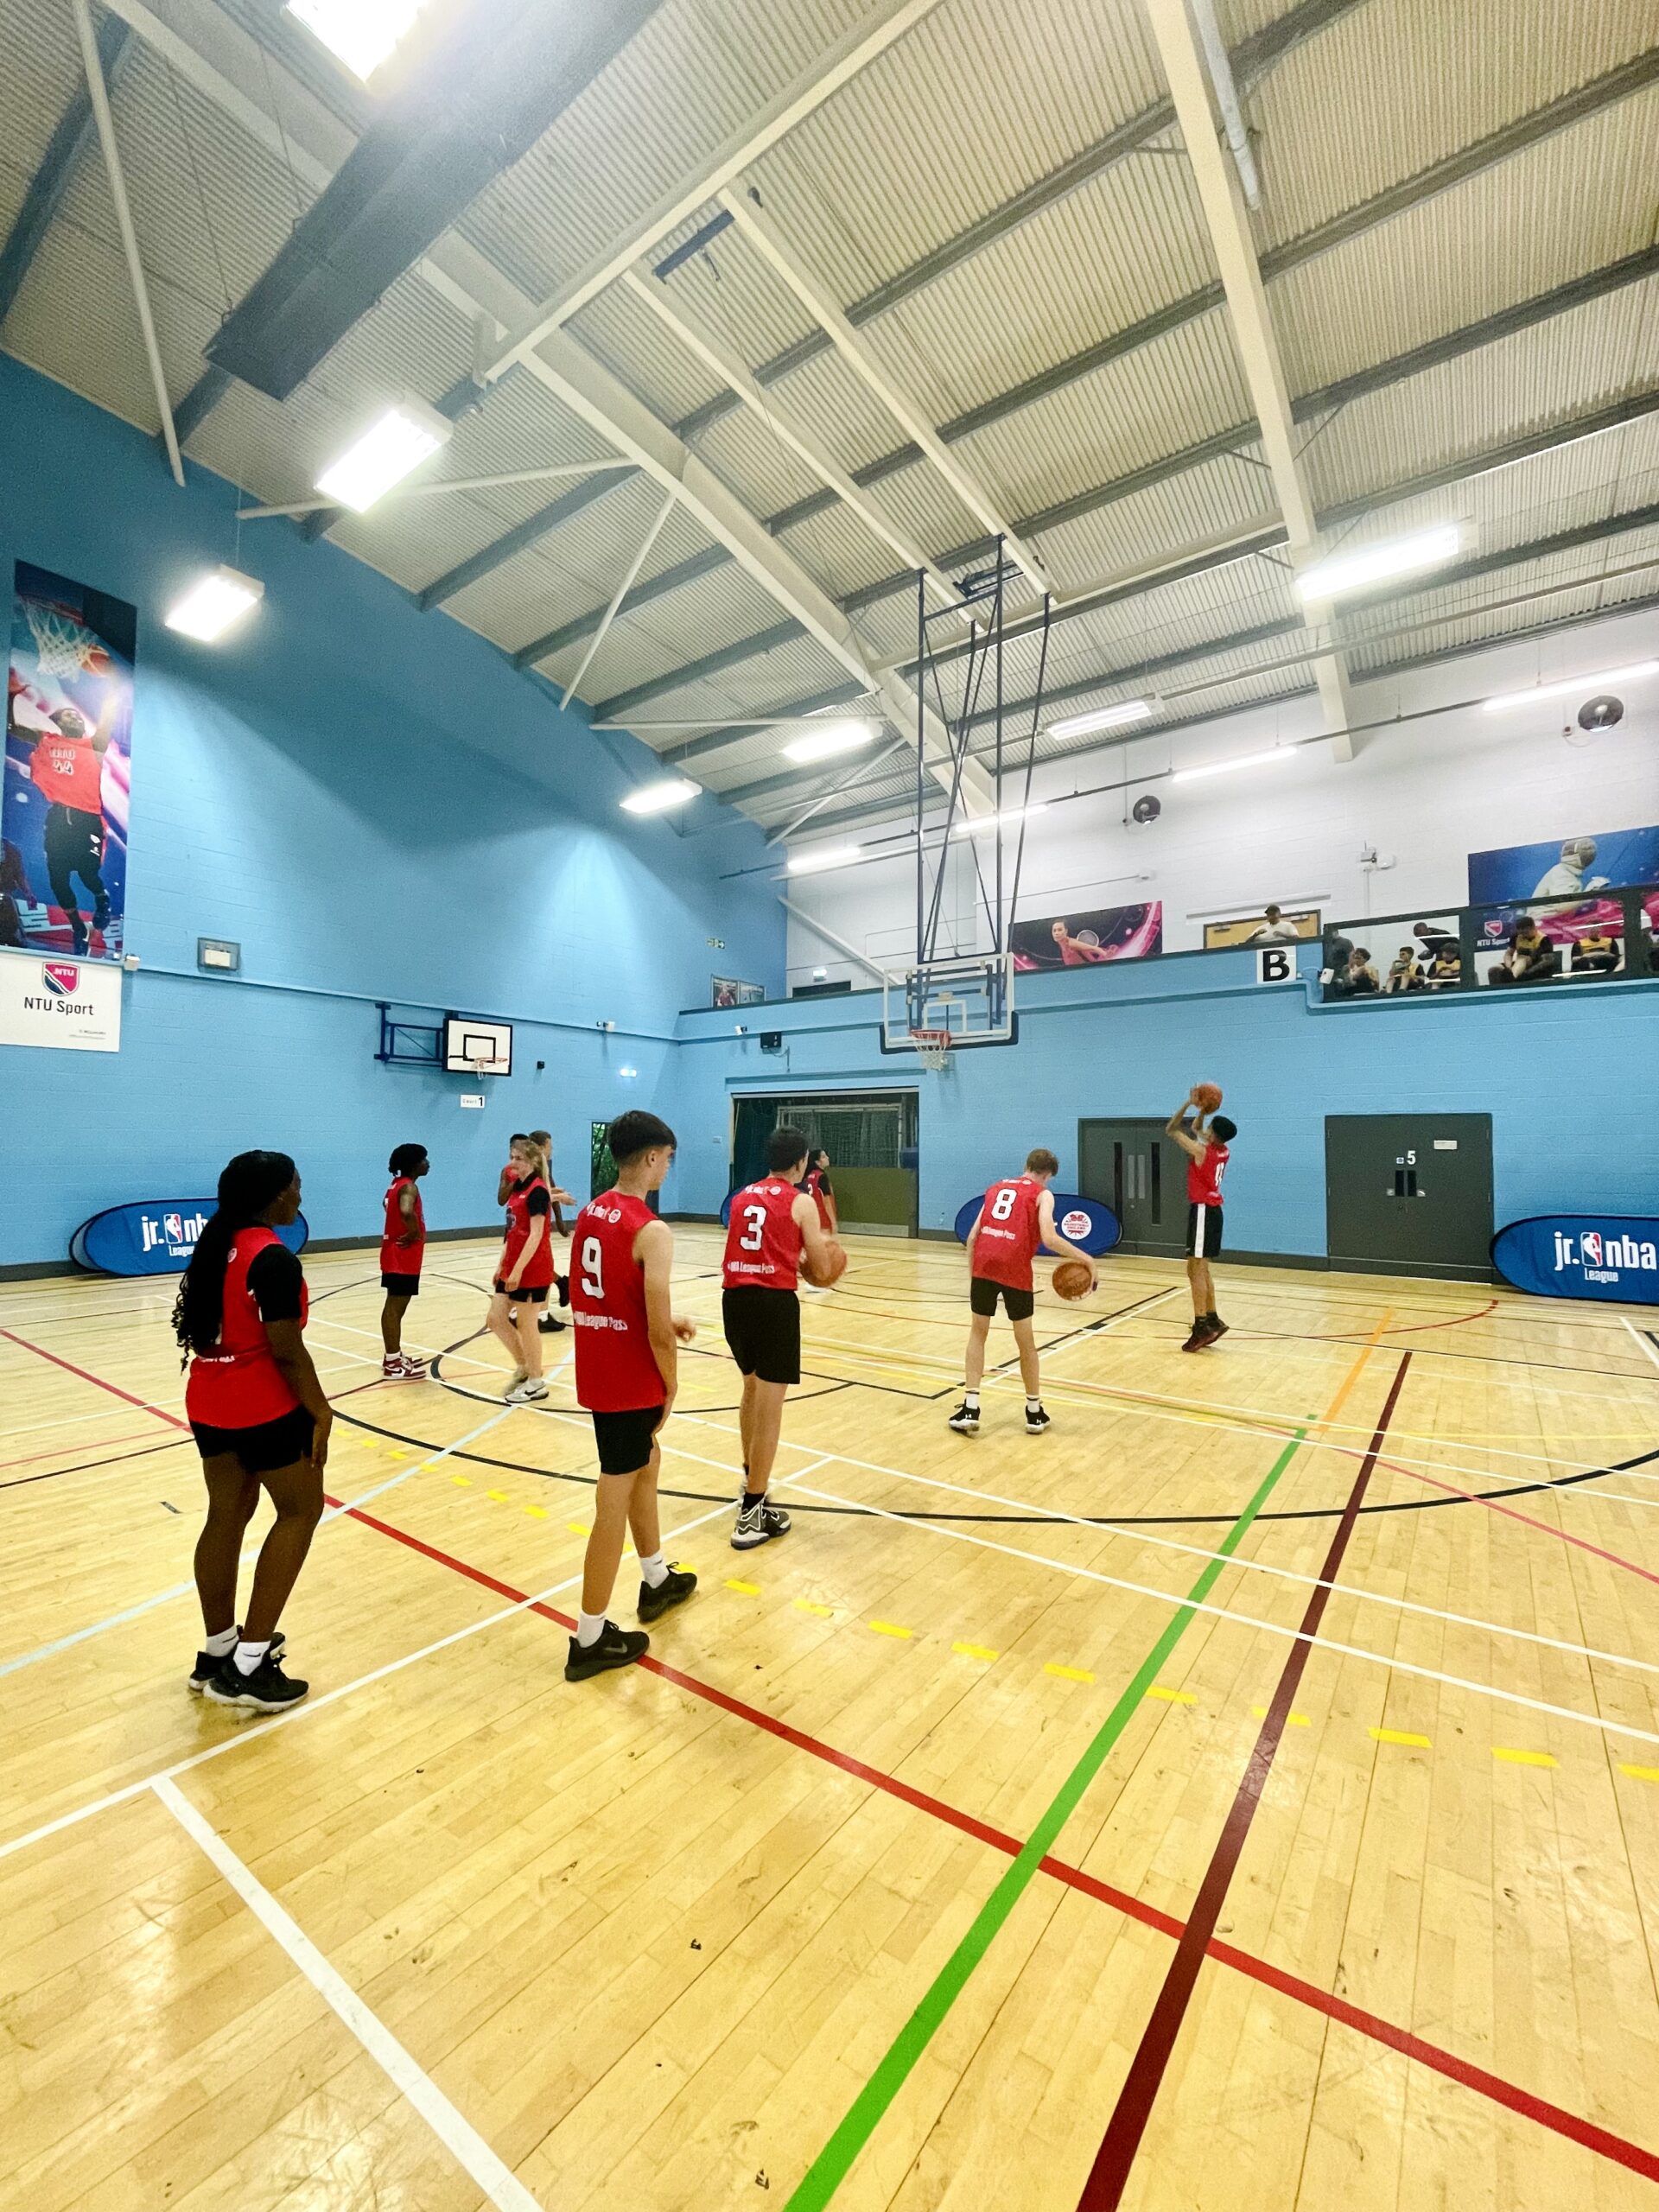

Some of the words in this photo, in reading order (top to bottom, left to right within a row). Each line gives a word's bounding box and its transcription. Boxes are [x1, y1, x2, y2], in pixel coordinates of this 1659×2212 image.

[54, 968, 74, 976] NTU
[1262, 950, 1290, 982] B
[24, 997, 52, 1011] NTU
[56, 1001, 94, 1015] Sport
[478, 1096, 483, 1107] 1
[1406, 1150, 1416, 1166] 5
[991, 1188, 1017, 1221] 8
[141, 1216, 165, 1252] jr.
[183, 1213, 209, 1243] nb
[740, 1205, 767, 1251] 3
[168, 1244, 195, 1257] Leagu
[1554, 1231, 1580, 1271] jr.
[1605, 1235, 1657, 1270] nba
[582, 1236, 605, 1299] 9
[1585, 1268, 1619, 1284] League
